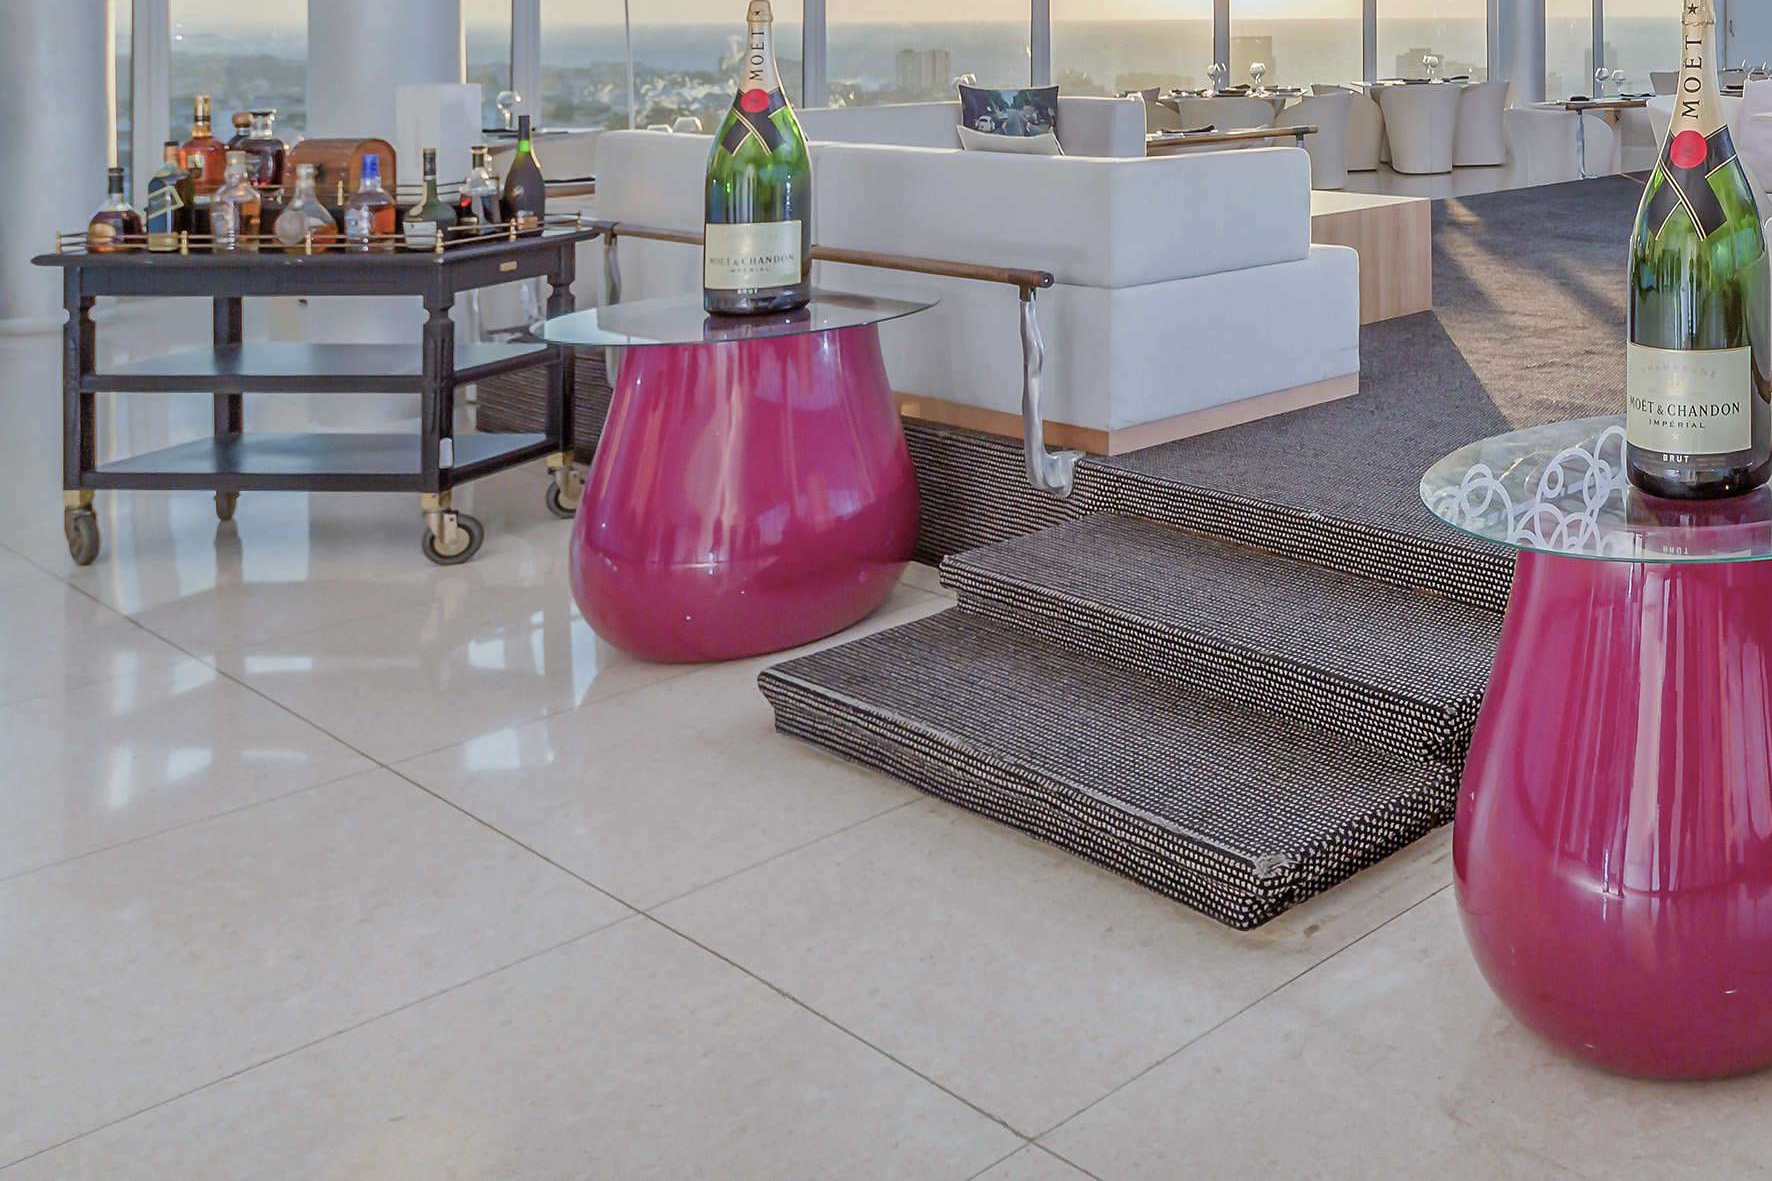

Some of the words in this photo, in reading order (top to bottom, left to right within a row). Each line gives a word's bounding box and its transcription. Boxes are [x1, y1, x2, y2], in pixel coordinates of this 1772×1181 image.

[1681, 35, 1702, 119] MOËT
[741, 254, 794, 265] CHANDON
[1641, 364, 1718, 379] CHAMPAGNE
[1629, 395, 1655, 414] MOËT
[1656, 405, 1664, 416] &
[1667, 401, 1740, 417] CHANDON
[1662, 454, 1690, 463] BRUT
